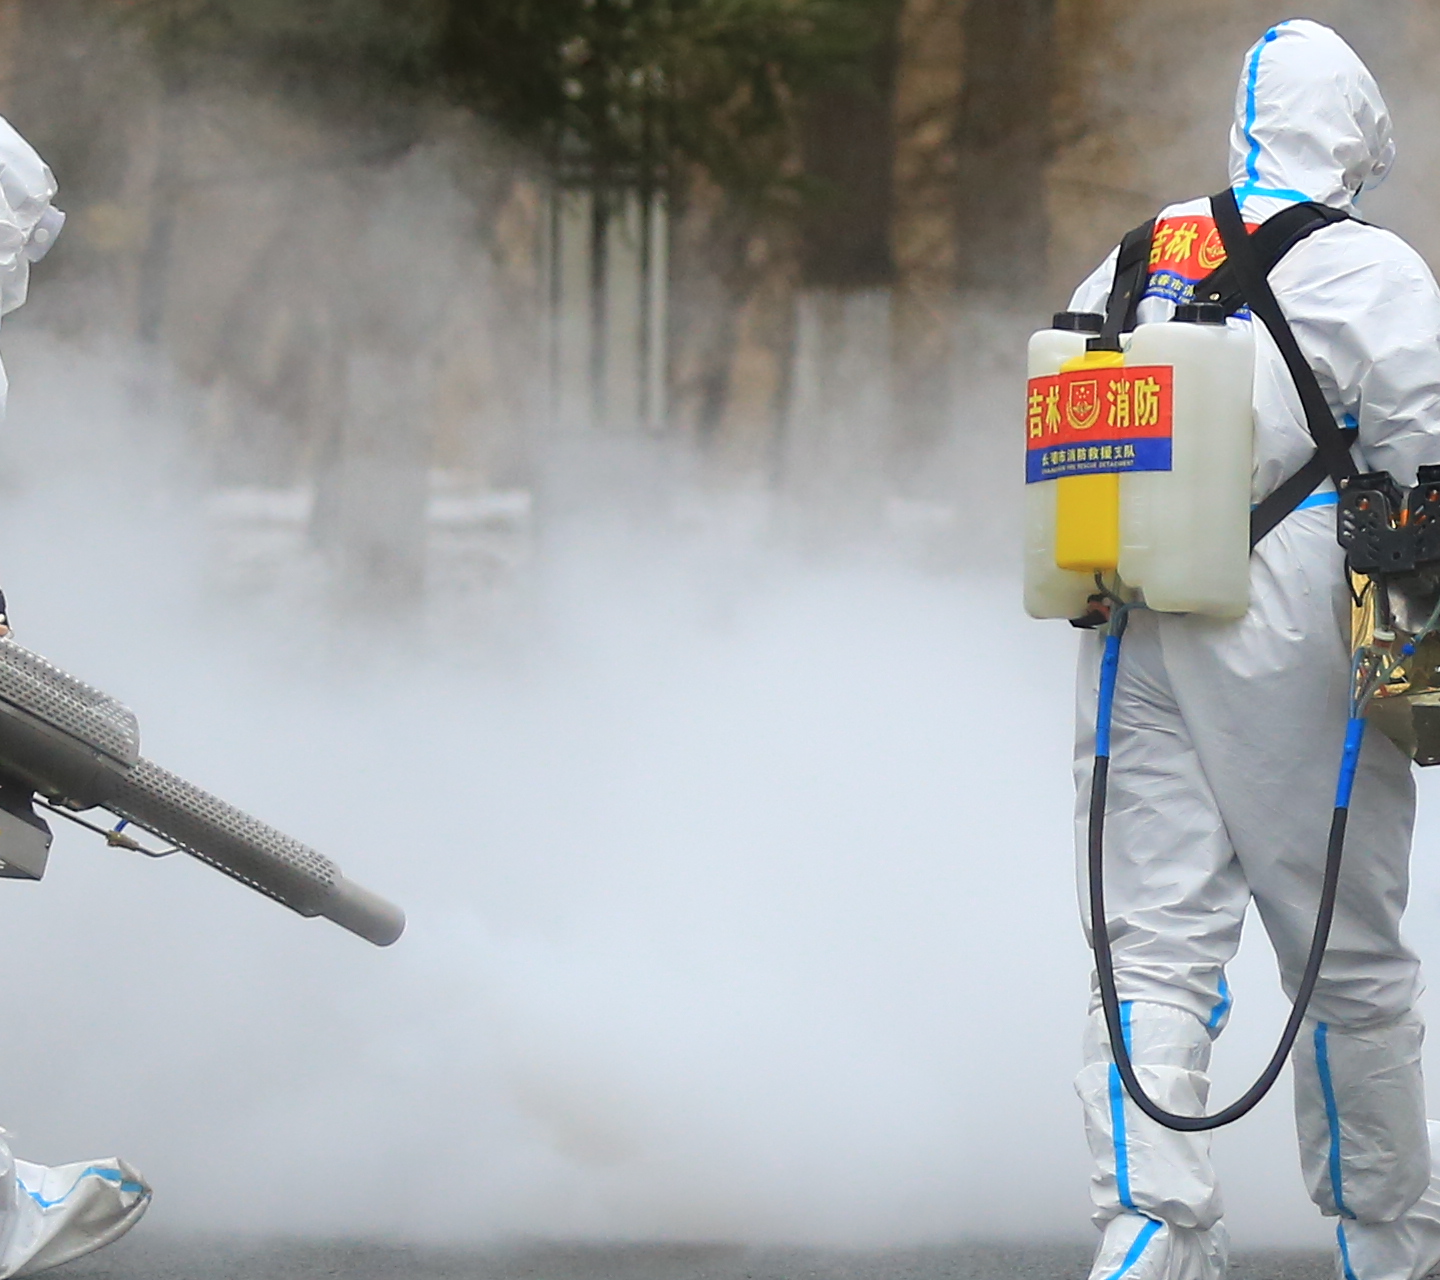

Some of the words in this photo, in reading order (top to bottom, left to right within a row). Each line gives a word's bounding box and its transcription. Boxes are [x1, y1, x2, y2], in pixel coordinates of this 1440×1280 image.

[1148, 221, 1199, 265] 吉林
[1028, 384, 1062, 439] 吉林
[1106, 376, 1161, 428] 消防
